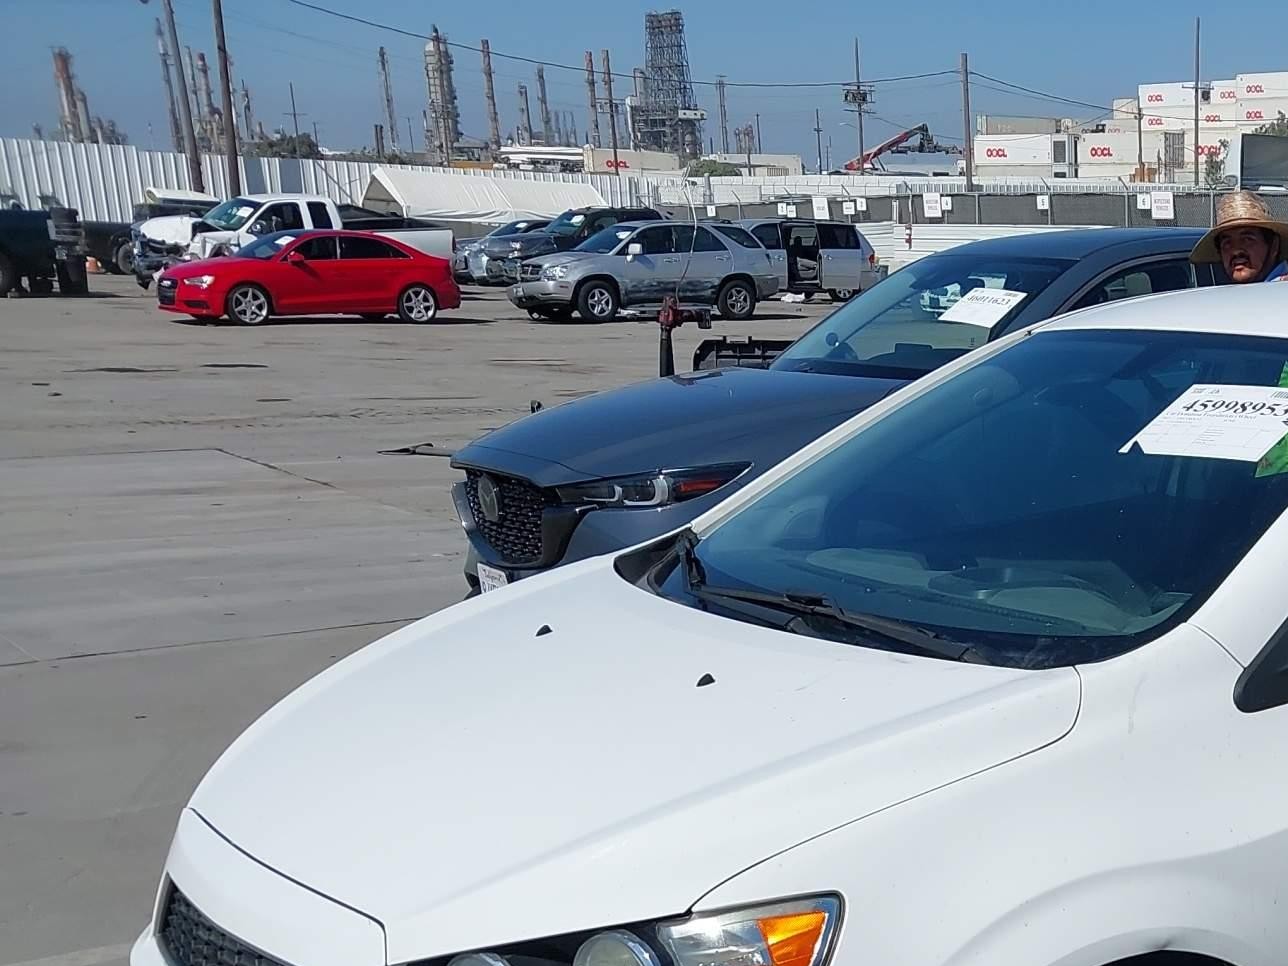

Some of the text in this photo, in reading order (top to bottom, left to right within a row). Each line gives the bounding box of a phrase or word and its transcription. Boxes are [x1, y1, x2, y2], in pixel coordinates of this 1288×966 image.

[1246, 85, 1264, 94] OOCL
[1148, 94, 1164, 103] OOCL
[1246, 111, 1264, 120] OOCL
[1148, 118, 1164, 126] OOCL
[986, 148, 1007, 158] OOCL
[1090, 147, 1113, 157] OOCL
